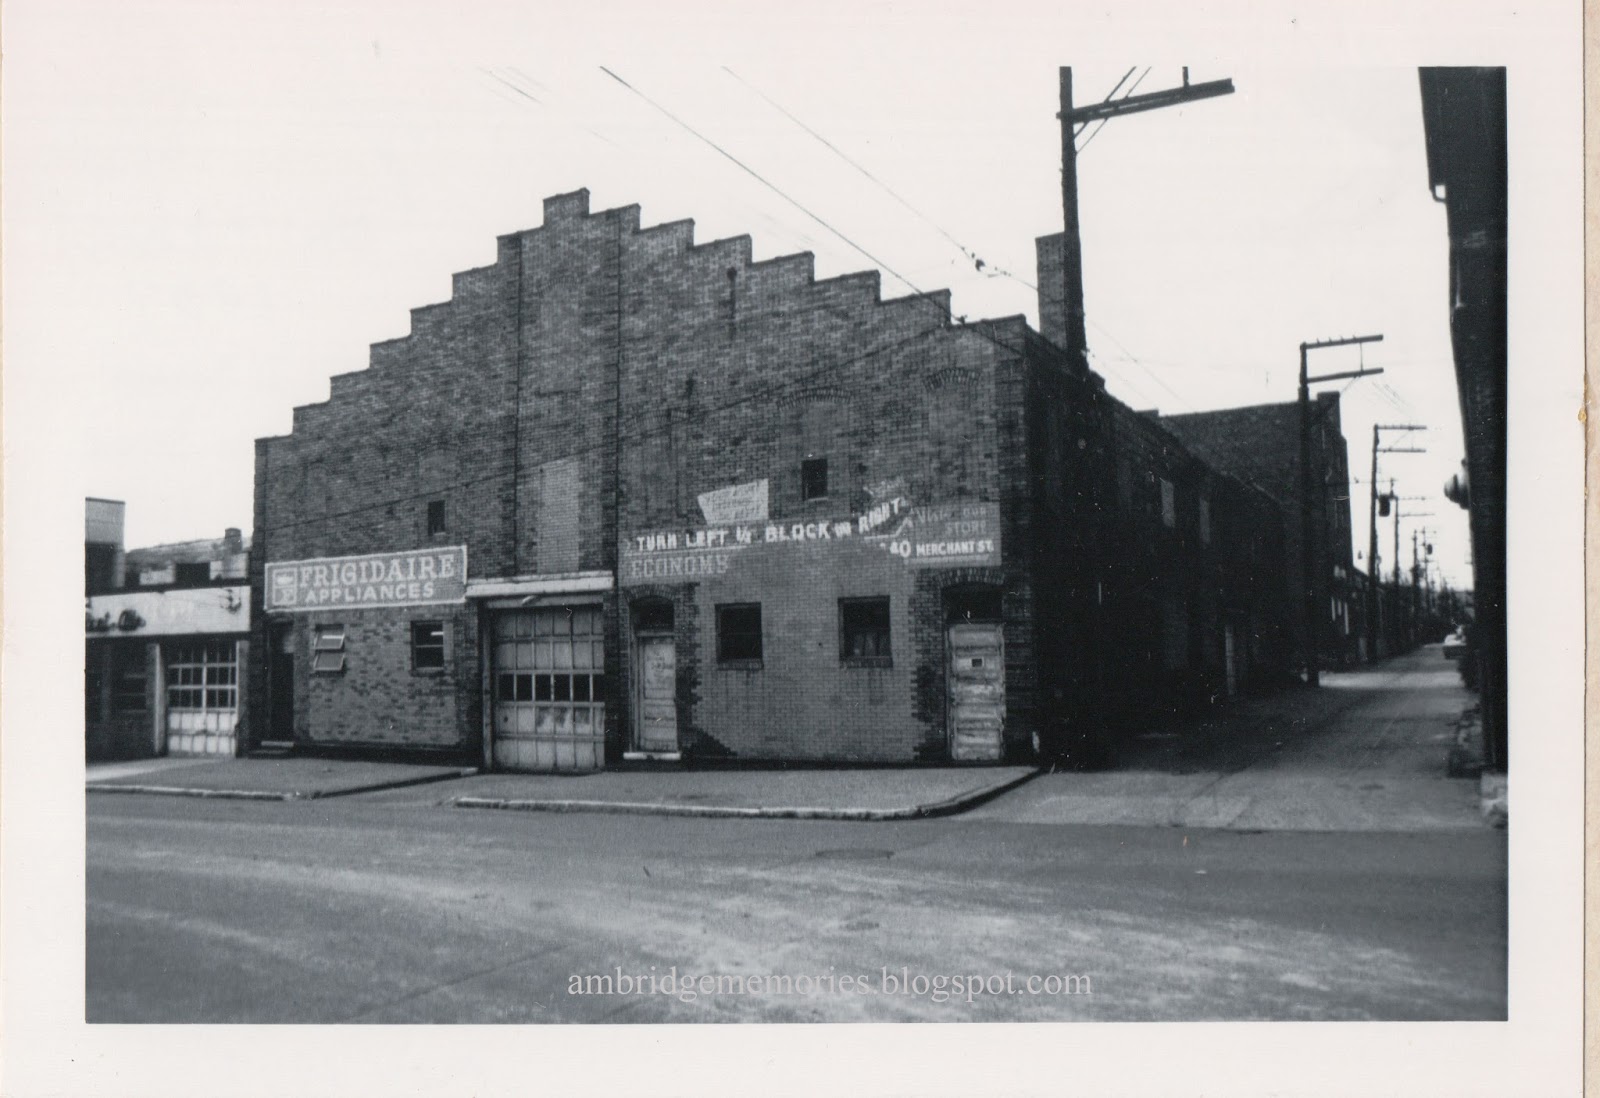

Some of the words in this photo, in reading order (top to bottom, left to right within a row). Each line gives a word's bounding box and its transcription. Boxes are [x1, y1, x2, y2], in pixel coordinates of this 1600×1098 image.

[636, 533, 677, 552] TURN
[685, 529, 729, 548] LEFT
[765, 520, 830, 543] BLOCK
[858, 497, 902, 534] RIGHT
[916, 541, 975, 557] MERCHANT
[299, 554, 456, 588] FRIGIDAIRE
[631, 554, 731, 579] ECONOMY
[304, 581, 436, 605] APPLIANCES
